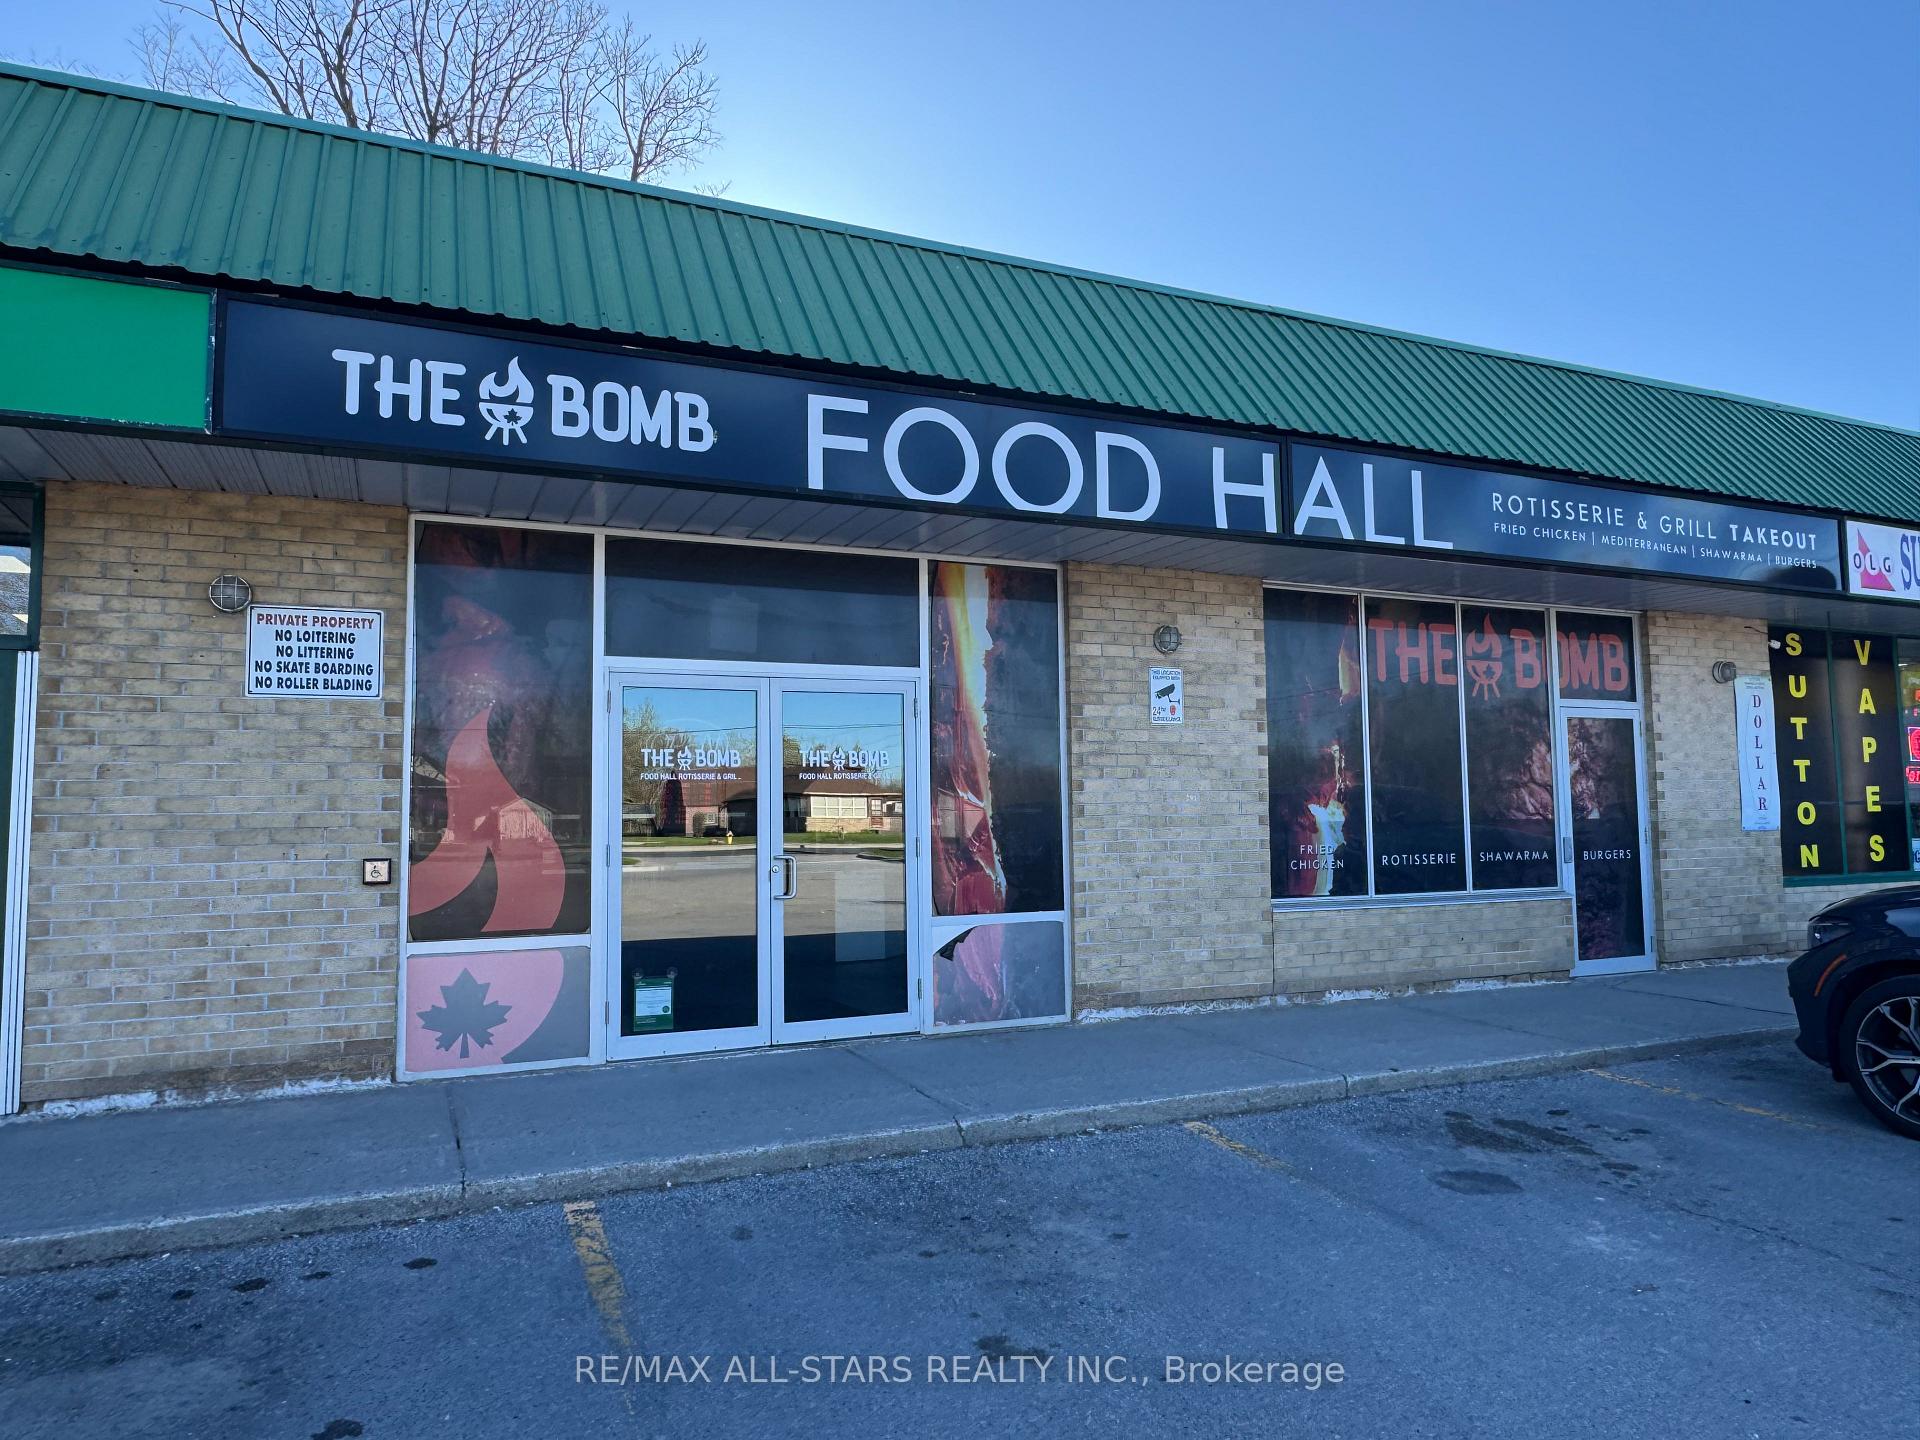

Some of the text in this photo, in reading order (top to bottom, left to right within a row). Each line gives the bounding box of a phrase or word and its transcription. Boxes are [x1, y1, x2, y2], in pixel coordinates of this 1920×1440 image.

[331, 348, 714, 453] THE BOMB
[806, 393, 1454, 550] FOOD HALL
[1492, 492, 1817, 551] ROTISSERIE & GRILL TAKEOUT
[1494, 522, 1817, 569] FRIED CHICKEN MEDITERRANEAN SHAWARMA BURGERS
[1853, 552, 1892, 573] OLG
[256, 613, 375, 630] PRIVATE PROPERTY
[275, 629, 356, 644] NO LOITERING
[276, 645, 354, 660] NO LITTERING
[1366, 618, 1629, 692] THE BOMB
[255, 660, 374, 676] NO SKATE BOARDING
[255, 676, 372, 691] NO ROLLER BLADING
[641, 748, 741, 768] THE BOMB
[1752, 694, 1768, 811] DOLLAR
[1785, 632, 1819, 868] SUTTON
[1853, 639, 1885, 862] VAPES
[799, 750, 890, 769] THE BOMB
[640, 772, 659, 780] FOOD
[660, 772, 677, 780] HALL
[678, 772, 716, 780] ROTISSERIE
[799, 772, 816, 780] FOOD
[817, 772, 832, 780] HALL
[1300, 844, 1334, 855] FRIED
[1479, 850, 1549, 863] SHAWARMA
[1583, 849, 1631, 860] BURGERS
[1290, 859, 1344, 870] CHICKEN
[1381, 853, 1456, 866] ROTISSERIE
